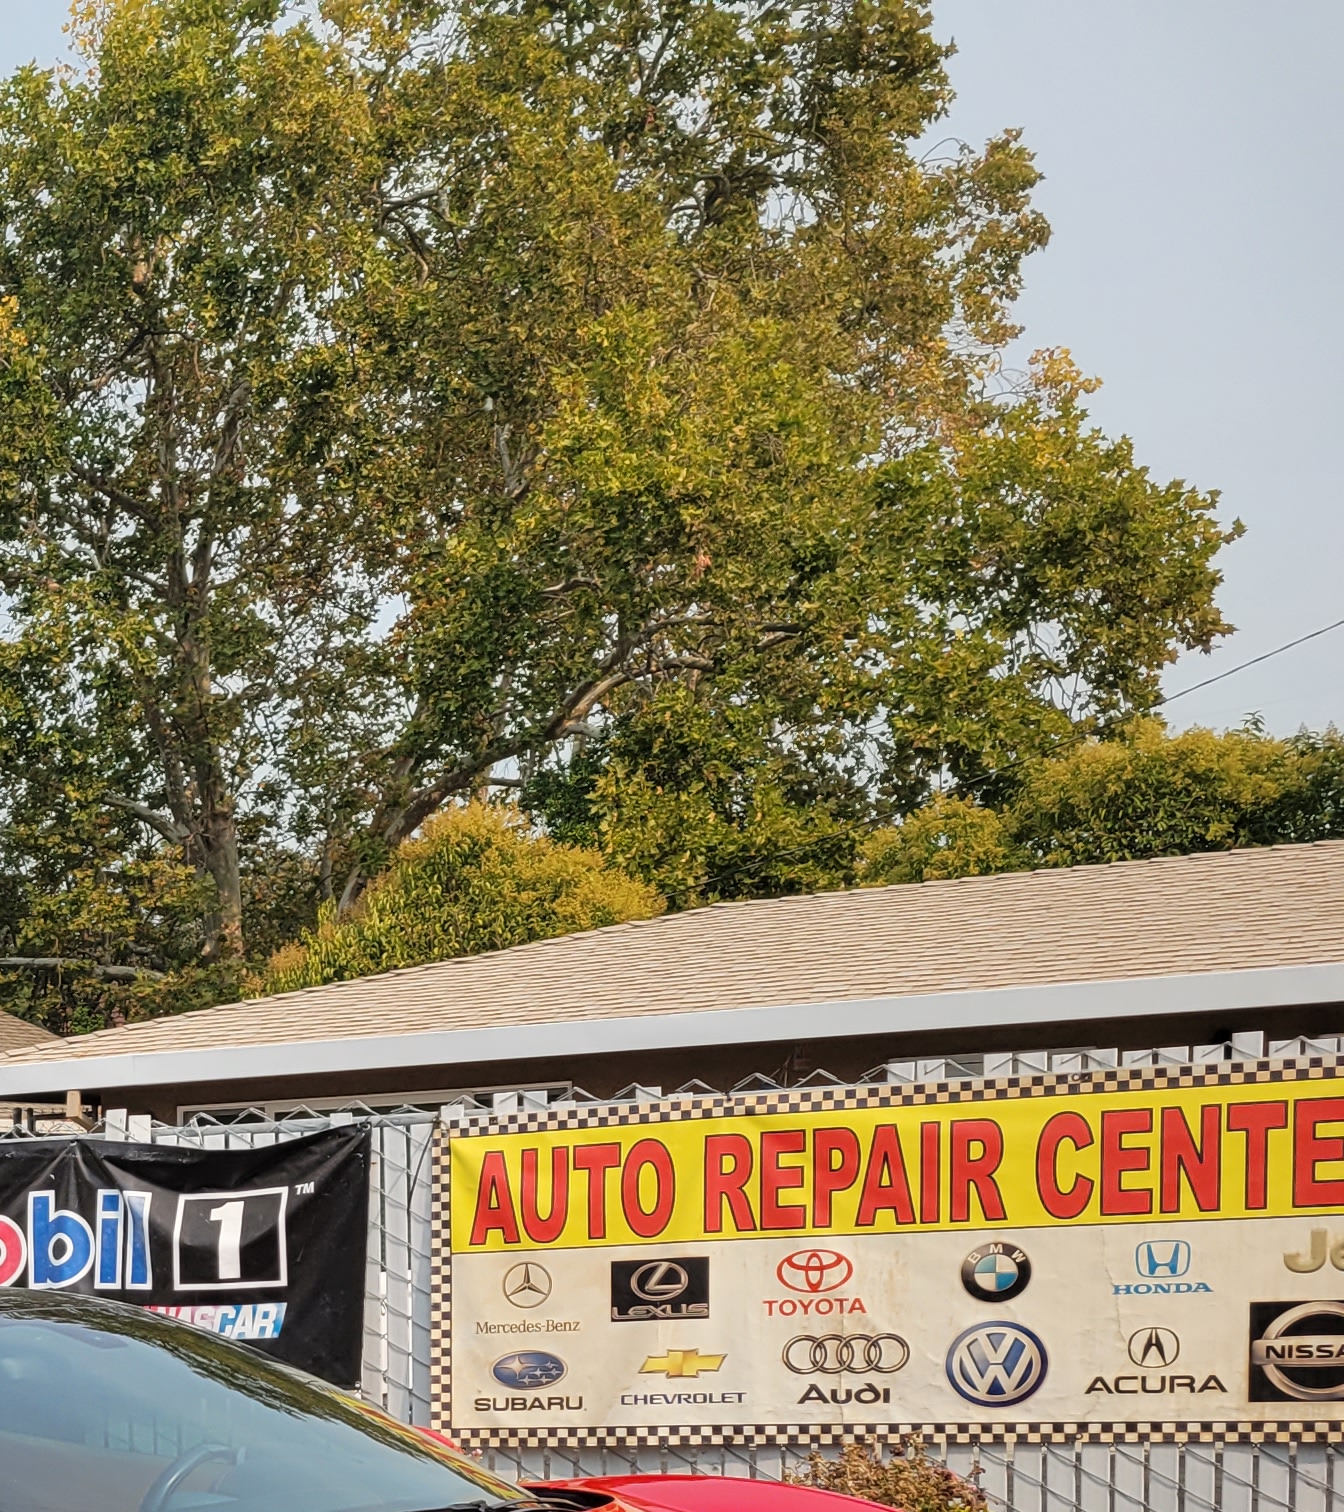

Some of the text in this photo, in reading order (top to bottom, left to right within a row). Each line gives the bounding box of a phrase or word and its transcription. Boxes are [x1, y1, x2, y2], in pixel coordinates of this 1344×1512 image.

[469, 1137, 676, 1246] AUTO
[703, 1118, 1008, 1232] REPAIR
[210, 1201, 244, 1279] 1
[967, 1243, 1026, 1264] BMW
[1113, 1282, 1214, 1295] HONDA
[613, 1303, 709, 1320] LEXUS
[762, 1298, 867, 1317] TOYOTA
[475, 1319, 581, 1335] Mercedes-Benz
[797, 1383, 891, 1404] Audi
[1084, 1374, 1229, 1395] ACURA
[474, 1395, 584, 1412] SUBARU
[620, 1392, 747, 1406] CHEVROLET
